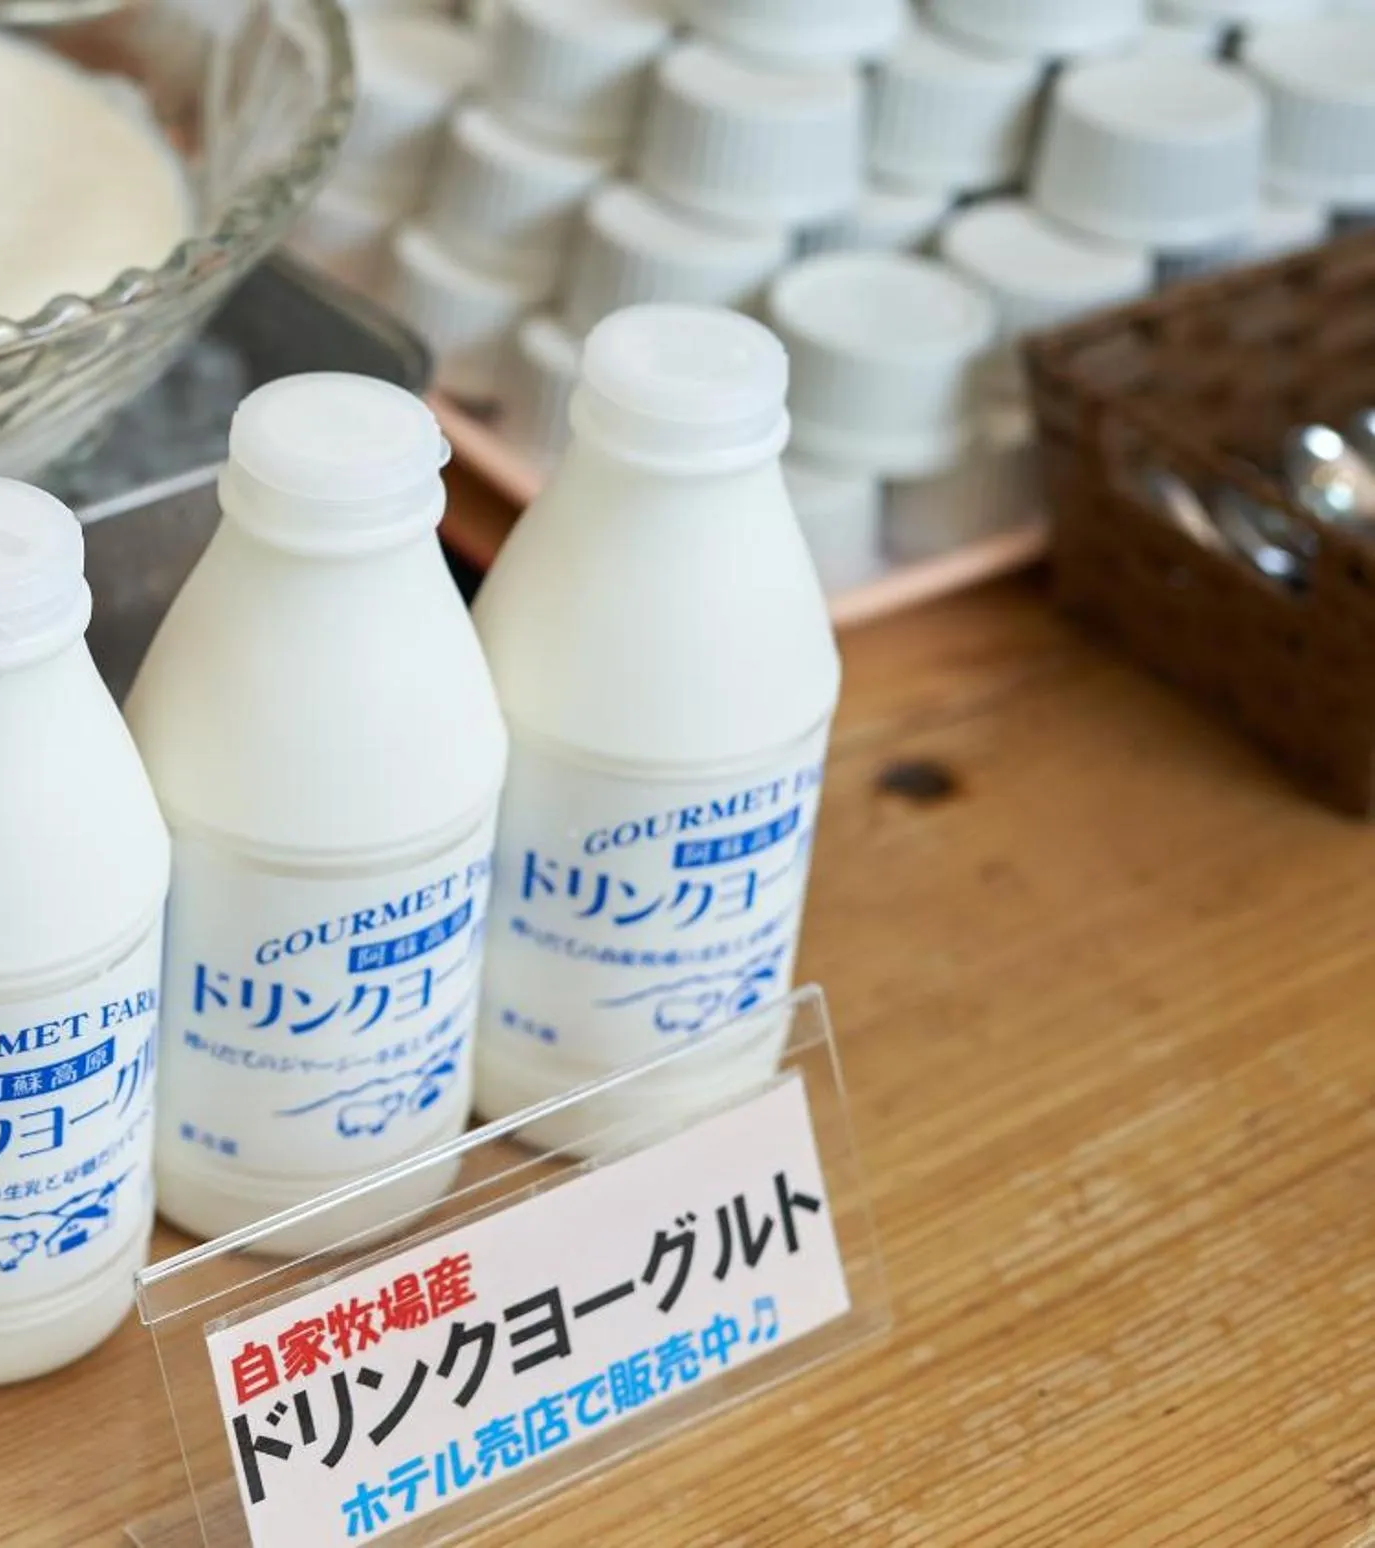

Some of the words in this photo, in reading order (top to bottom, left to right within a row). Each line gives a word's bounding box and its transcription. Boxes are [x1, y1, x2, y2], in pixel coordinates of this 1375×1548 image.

[582, 777, 787, 858] GOURMET
[255, 873, 458, 966] GOURMET
[230, 1251, 478, 1406] 自家牧場産
[231, 1170, 822, 1505] ドリンクヨーグルト
